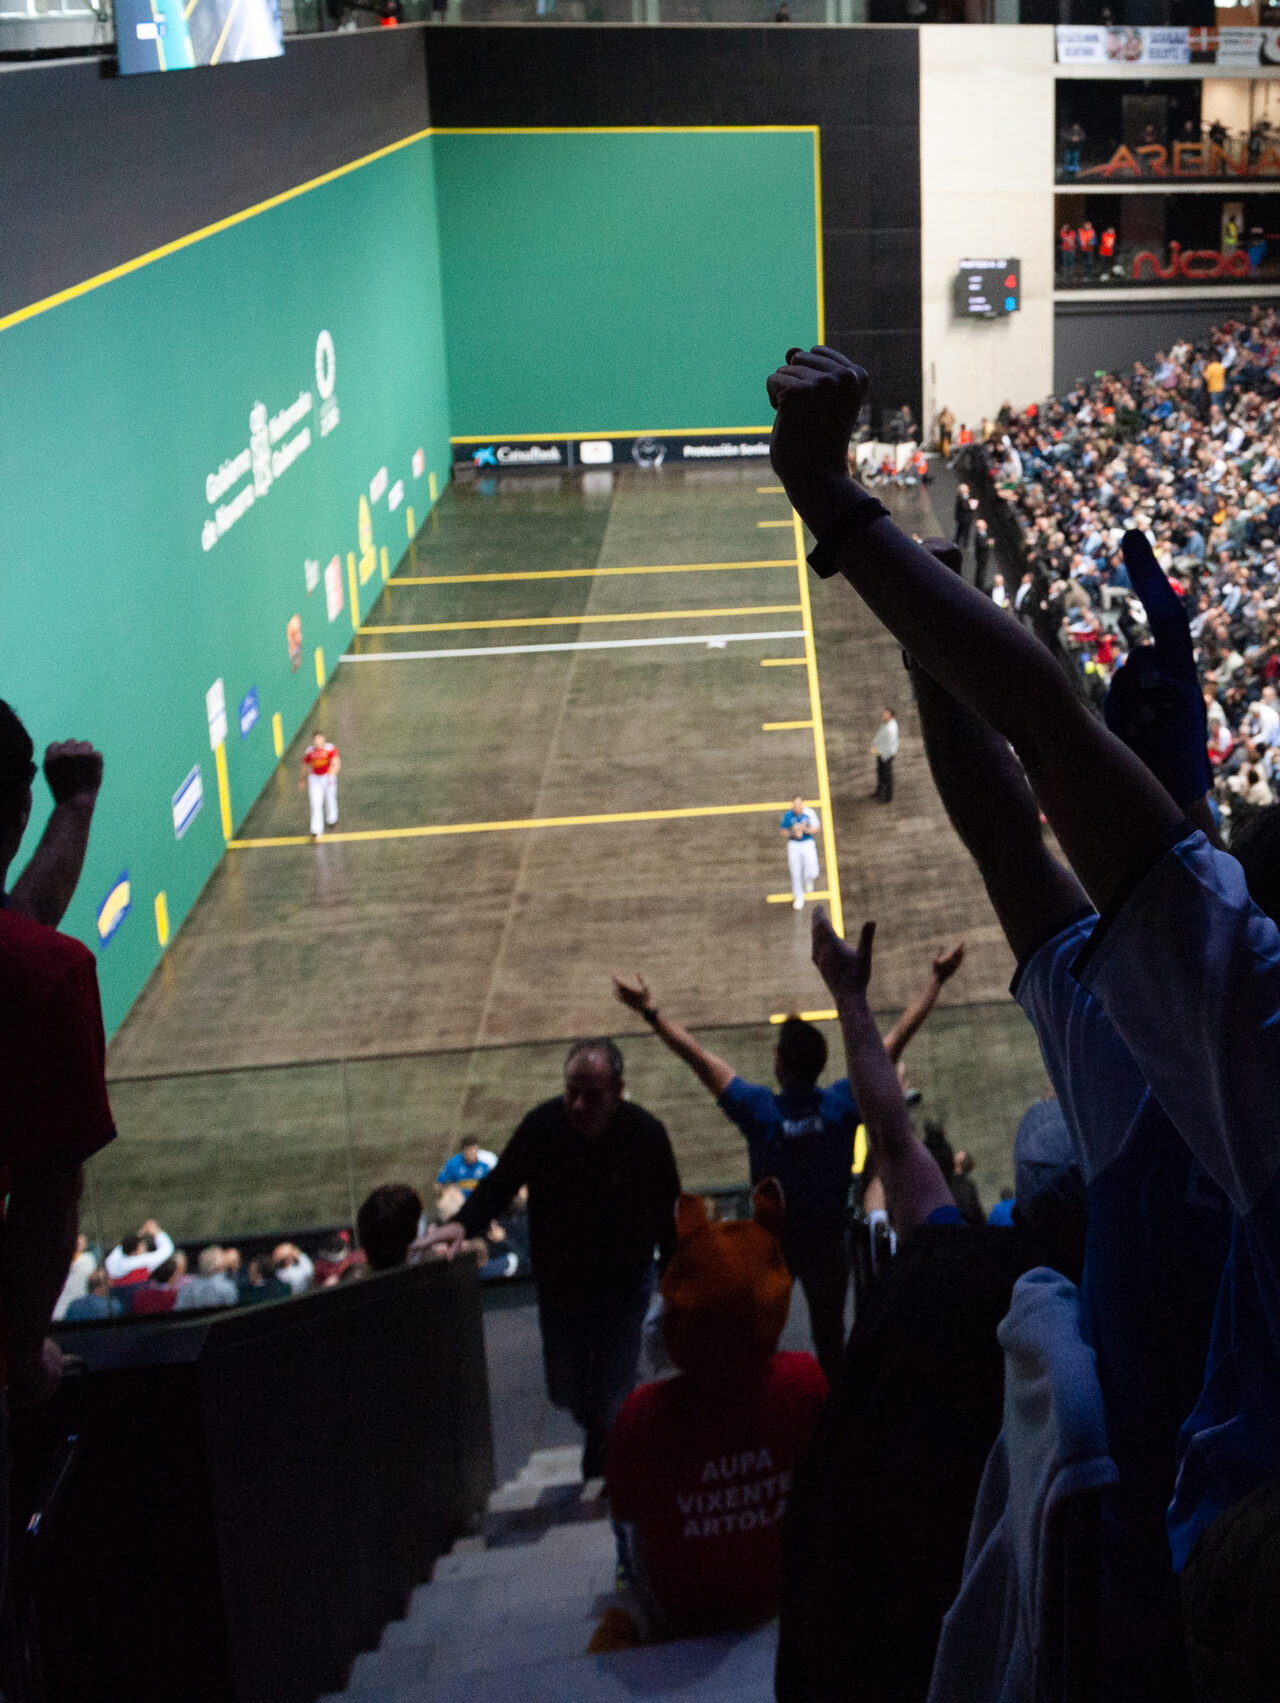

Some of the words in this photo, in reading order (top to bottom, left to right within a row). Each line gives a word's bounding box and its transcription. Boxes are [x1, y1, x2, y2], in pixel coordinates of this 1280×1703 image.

[496, 446, 562, 461] CaixaBank
[740, 442, 770, 456] Senio
[701, 1447, 773, 1483] AUPA
[675, 1467, 792, 1514] VIXENTE
